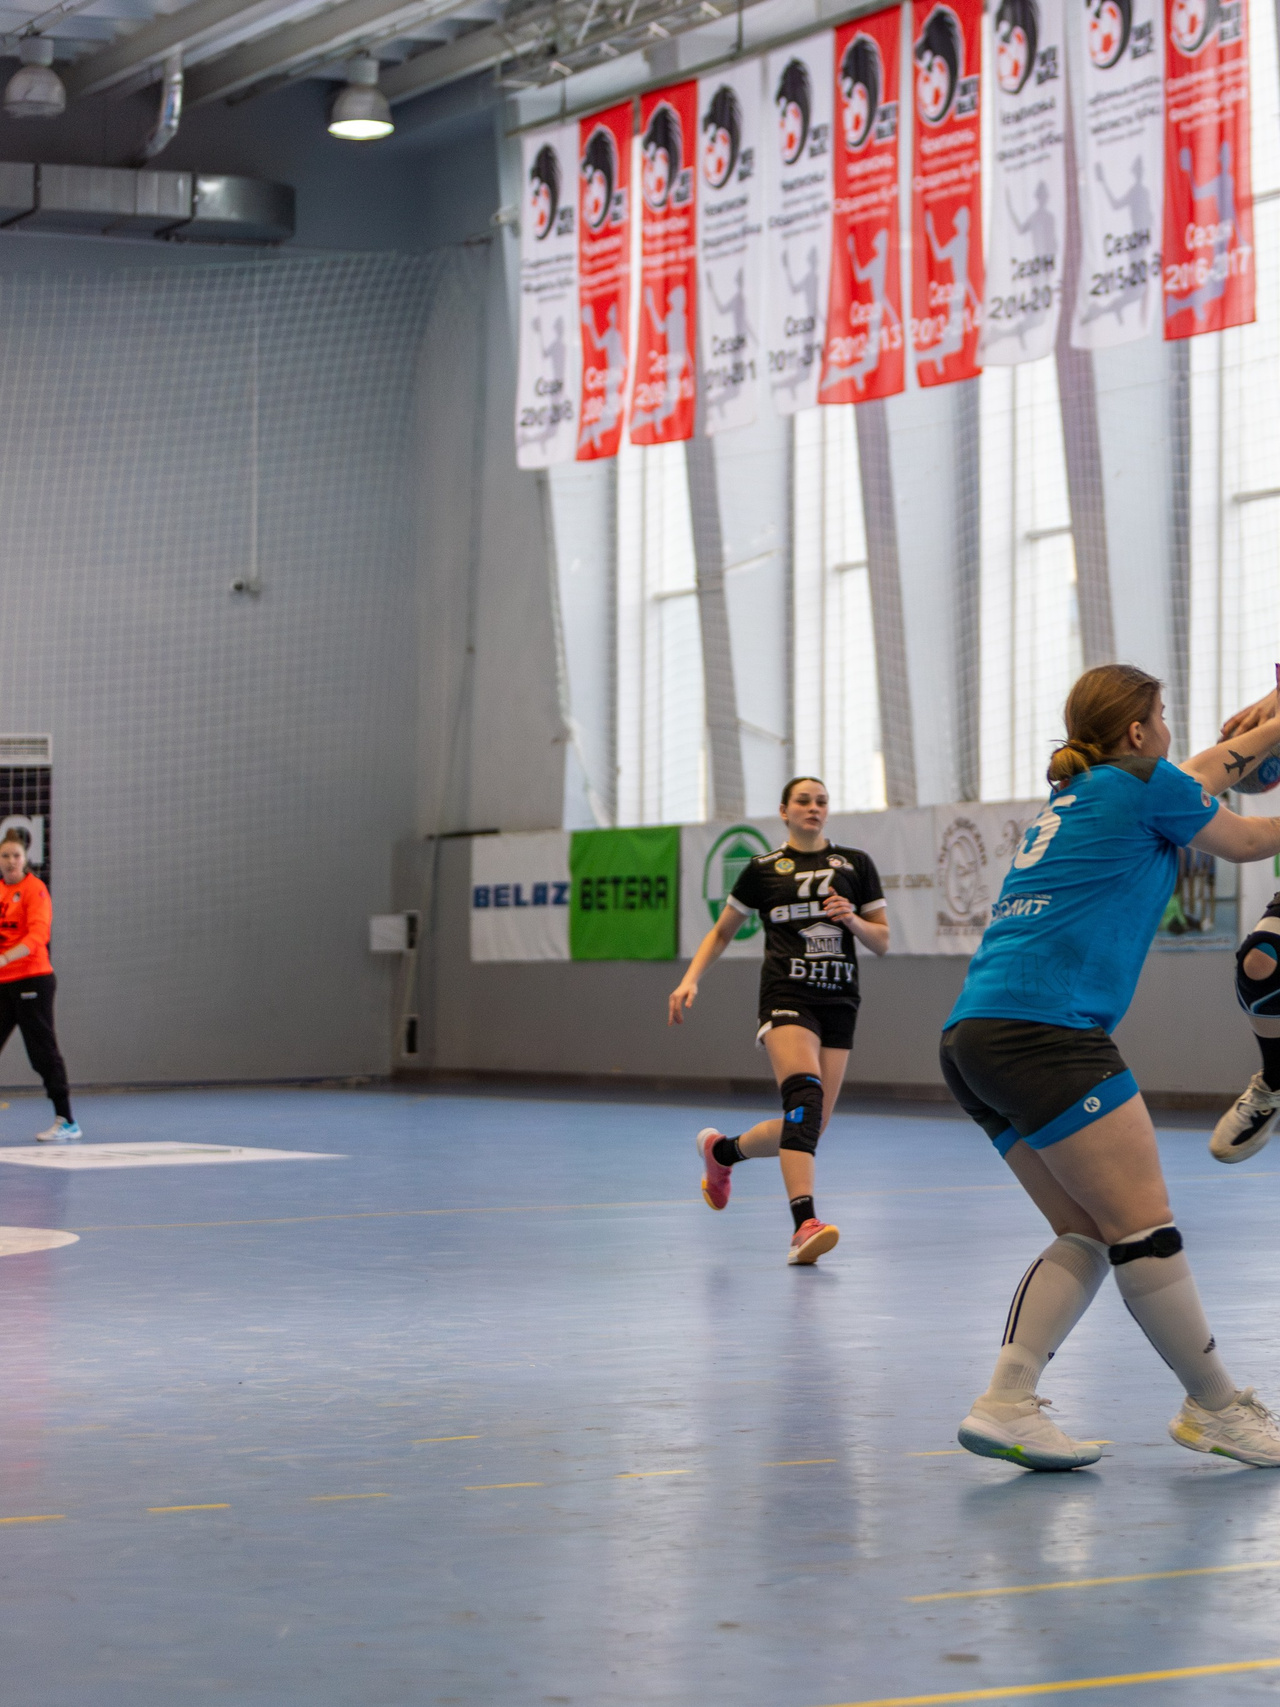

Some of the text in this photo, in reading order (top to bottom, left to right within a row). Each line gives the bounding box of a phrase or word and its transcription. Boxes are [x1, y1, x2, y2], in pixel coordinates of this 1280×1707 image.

[472, 878, 569, 909] BELAZ
[580, 875, 669, 911] BETERA
[794, 870, 835, 898] 77
[769, 901, 829, 924] BEL
[788, 958, 856, 983] БНТУ
